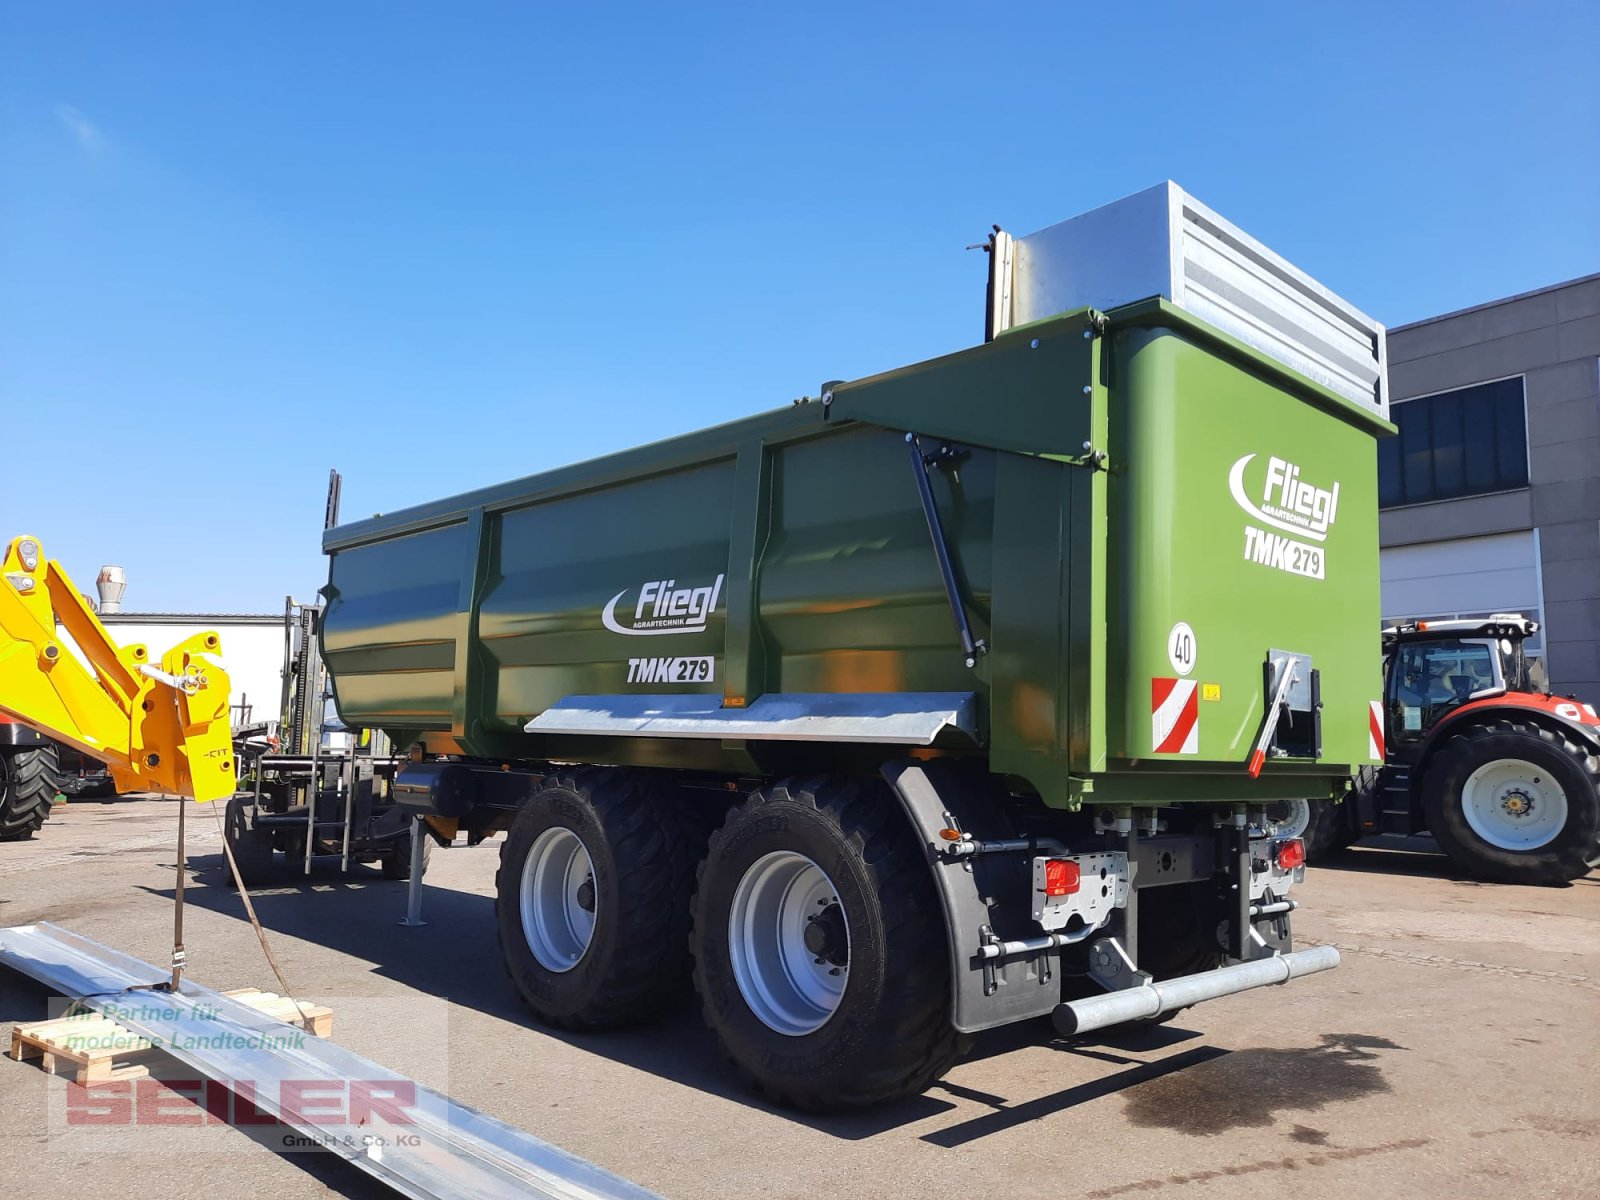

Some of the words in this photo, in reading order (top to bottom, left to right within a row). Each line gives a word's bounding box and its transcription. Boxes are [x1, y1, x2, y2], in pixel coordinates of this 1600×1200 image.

[1263, 456, 1340, 533] Fliegl
[1261, 503, 1310, 528] AGRARTECHNIK
[634, 573, 725, 625] Fliegl
[633, 618, 685, 629] AGRARTECHNIK
[1174, 632, 1191, 665] 40
